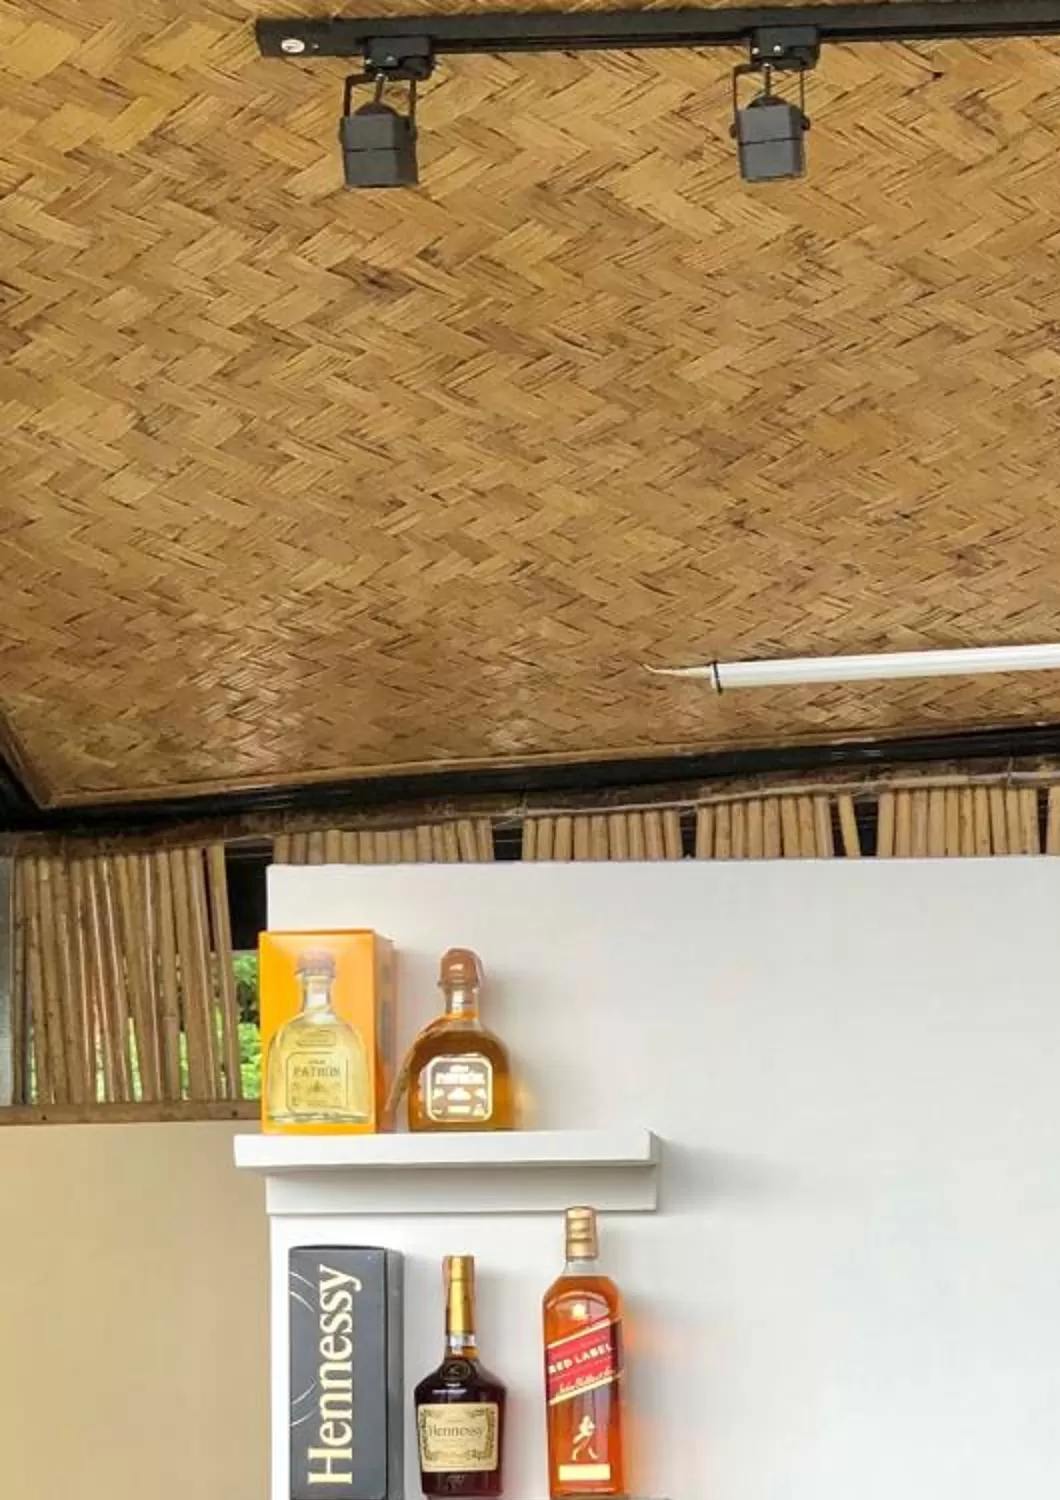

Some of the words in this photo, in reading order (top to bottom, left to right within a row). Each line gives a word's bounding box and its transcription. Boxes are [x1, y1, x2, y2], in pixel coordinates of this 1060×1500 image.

[307, 1264, 362, 1485] Hennessy
[548, 1358, 574, 1375] RED
[574, 1343, 613, 1364] LABEL
